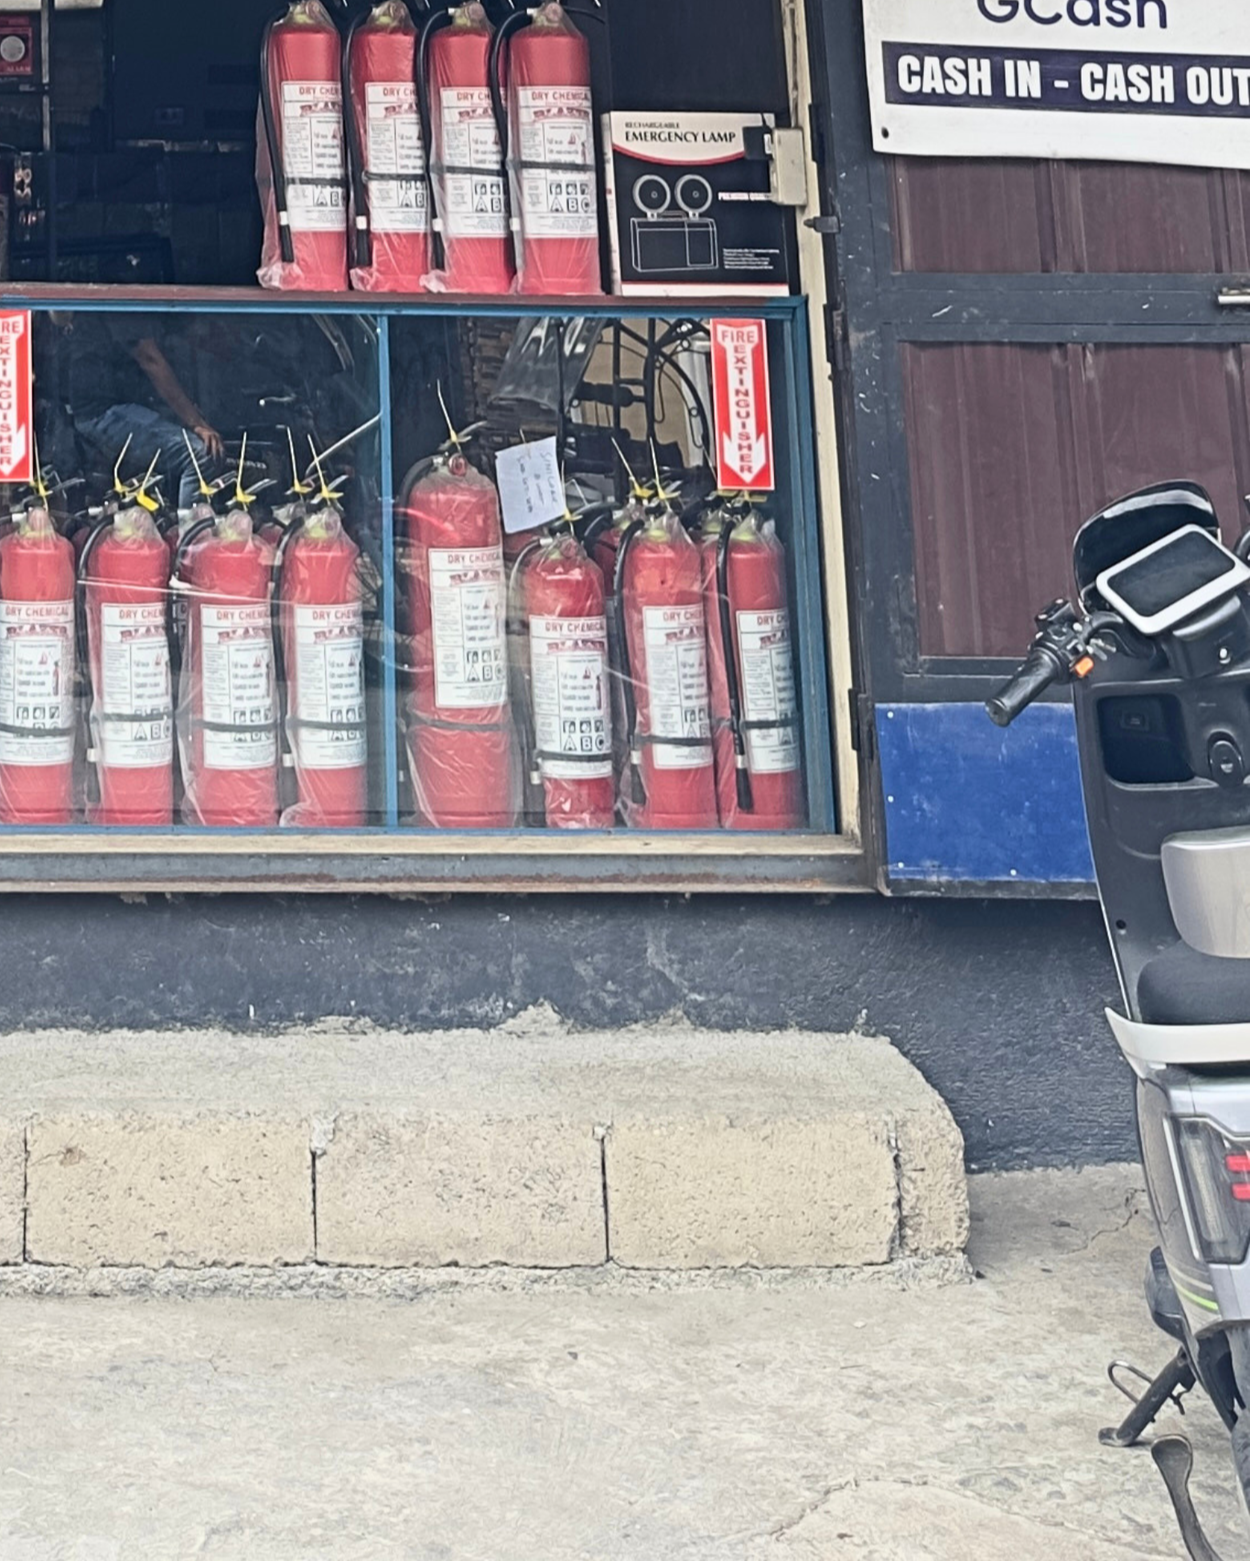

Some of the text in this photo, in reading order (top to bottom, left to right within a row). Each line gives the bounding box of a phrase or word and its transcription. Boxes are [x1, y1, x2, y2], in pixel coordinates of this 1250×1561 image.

[897, 54, 993, 97] CASH
[1003, 59, 1042, 99] IN
[1080, 62, 1175, 104] CASH
[1186, 66, 1250, 107] OUT
[531, 91, 549, 101] DRY
[625, 131, 736, 143] EMERGENCY LAMP
[721, 330, 755, 343] FIRE
[733, 344, 753, 474] EXTINGUISHER
[447, 554, 465, 564] DRY
[5, 606, 22, 616] DRY
[119, 609, 137, 619] DRY
[216, 610, 235, 621] DRY
[312, 610, 331, 621] DRY
[663, 611, 681, 622] DRY
[757, 615, 775, 626] DRY
[545, 622, 563, 632] DRY
